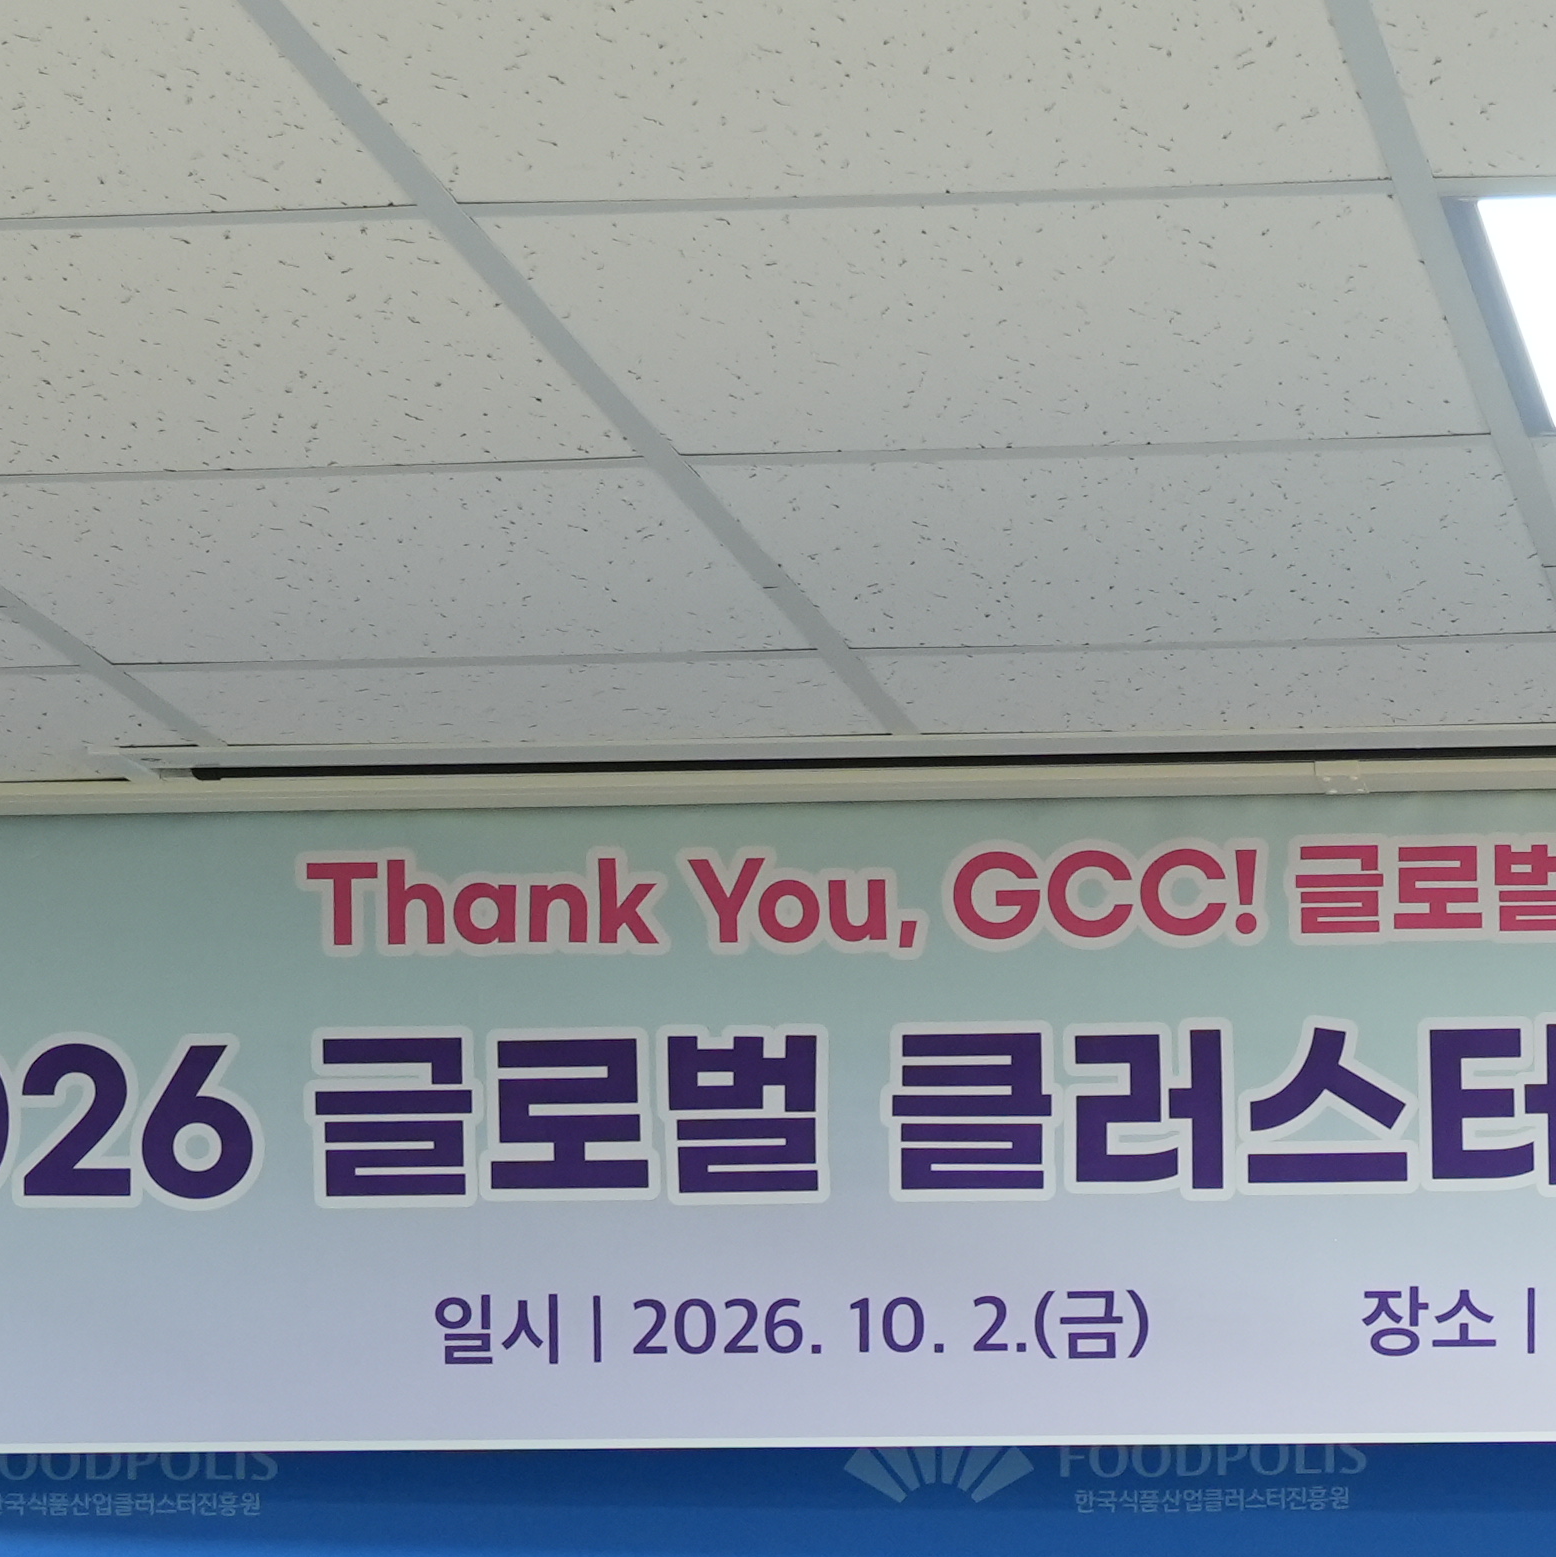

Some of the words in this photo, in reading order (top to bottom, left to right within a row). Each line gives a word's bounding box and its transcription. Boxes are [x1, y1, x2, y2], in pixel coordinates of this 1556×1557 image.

[307, 858, 658, 945] Thank
[688, 858, 917, 948] You,
[953, 849, 1257, 939] GCC!
[315, 1035, 818, 1196] 글로벌
[435, 1294, 558, 1364] 일시
[633, 1298, 821, 1354] 2026.
[850, 1297, 944, 1353] 10.
[974, 1290, 1148, 1359] 2.(금)
[1362, 1286, 1496, 1356] 장소
[1059, 1444, 1367, 1477] FOODPOLIS
[1075, 1486, 1349, 1513] 한국식품산업클러스터진흥원
